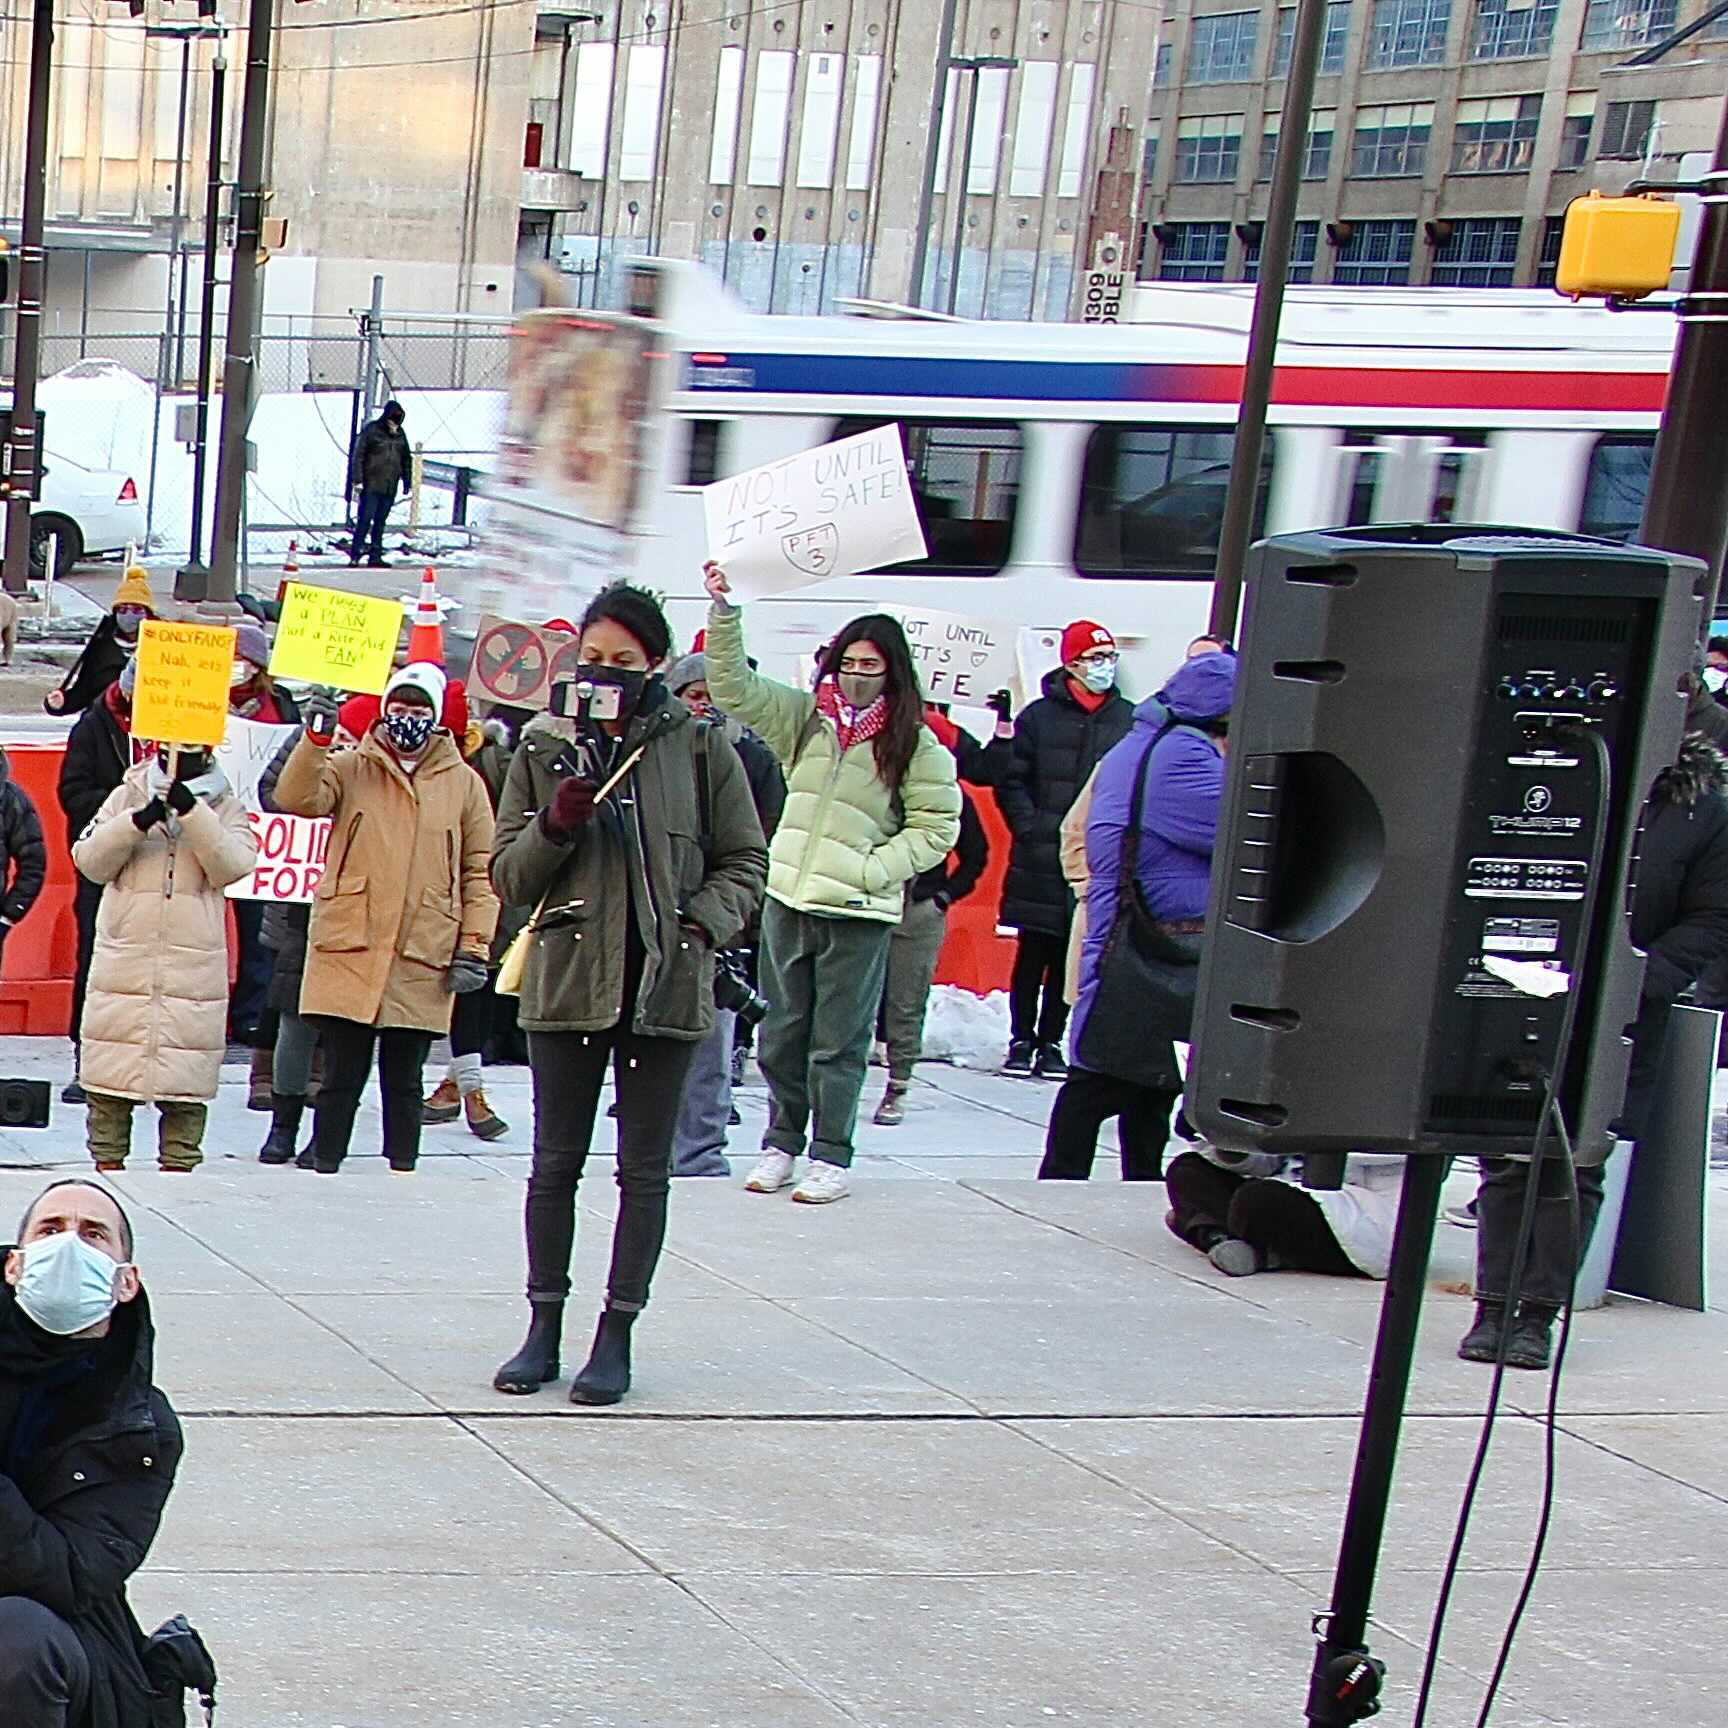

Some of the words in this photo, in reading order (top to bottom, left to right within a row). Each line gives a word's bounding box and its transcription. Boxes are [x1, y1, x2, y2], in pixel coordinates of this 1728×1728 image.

[727, 457, 799, 516] NOT
[814, 440, 893, 485] UNTIL
[817, 465, 903, 515] SAFE!
[320, 608, 367, 628] PLAN
[945, 623, 997, 648] UNTIL
[252, 866, 325, 899] FOR
